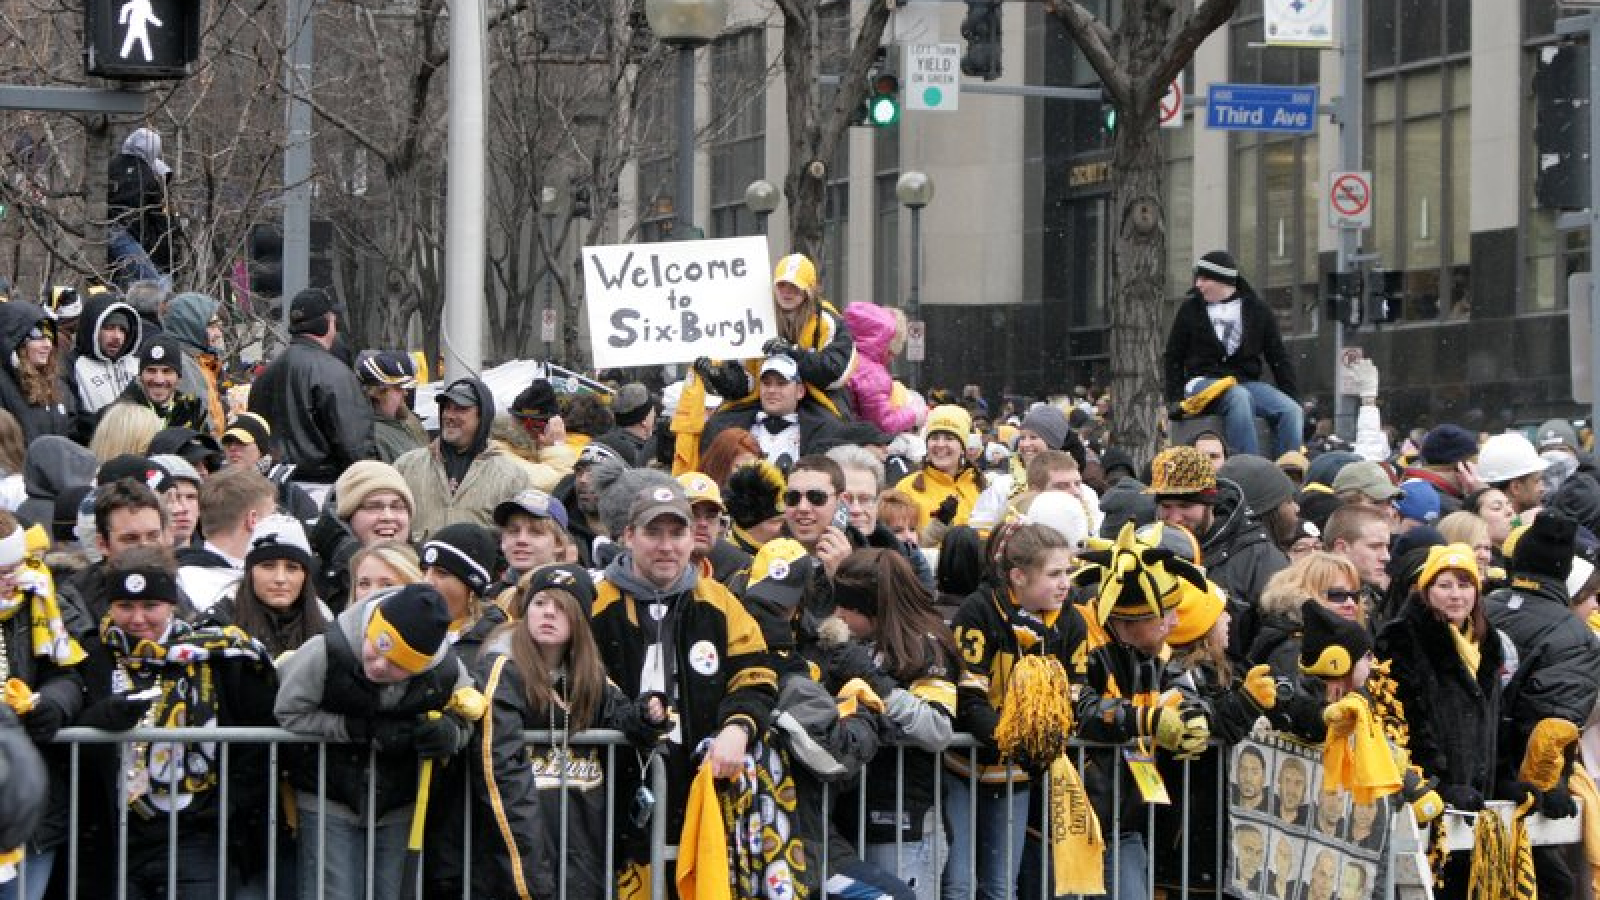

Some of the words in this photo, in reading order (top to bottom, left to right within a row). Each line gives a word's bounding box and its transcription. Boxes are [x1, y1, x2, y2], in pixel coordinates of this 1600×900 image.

[917, 57, 951, 72] YIELD
[1215, 105, 1264, 125] Third
[1271, 107, 1307, 127] Ave
[591, 252, 747, 290] Welcome
[667, 288, 693, 311] to
[607, 307, 765, 349] Six-Burgh
